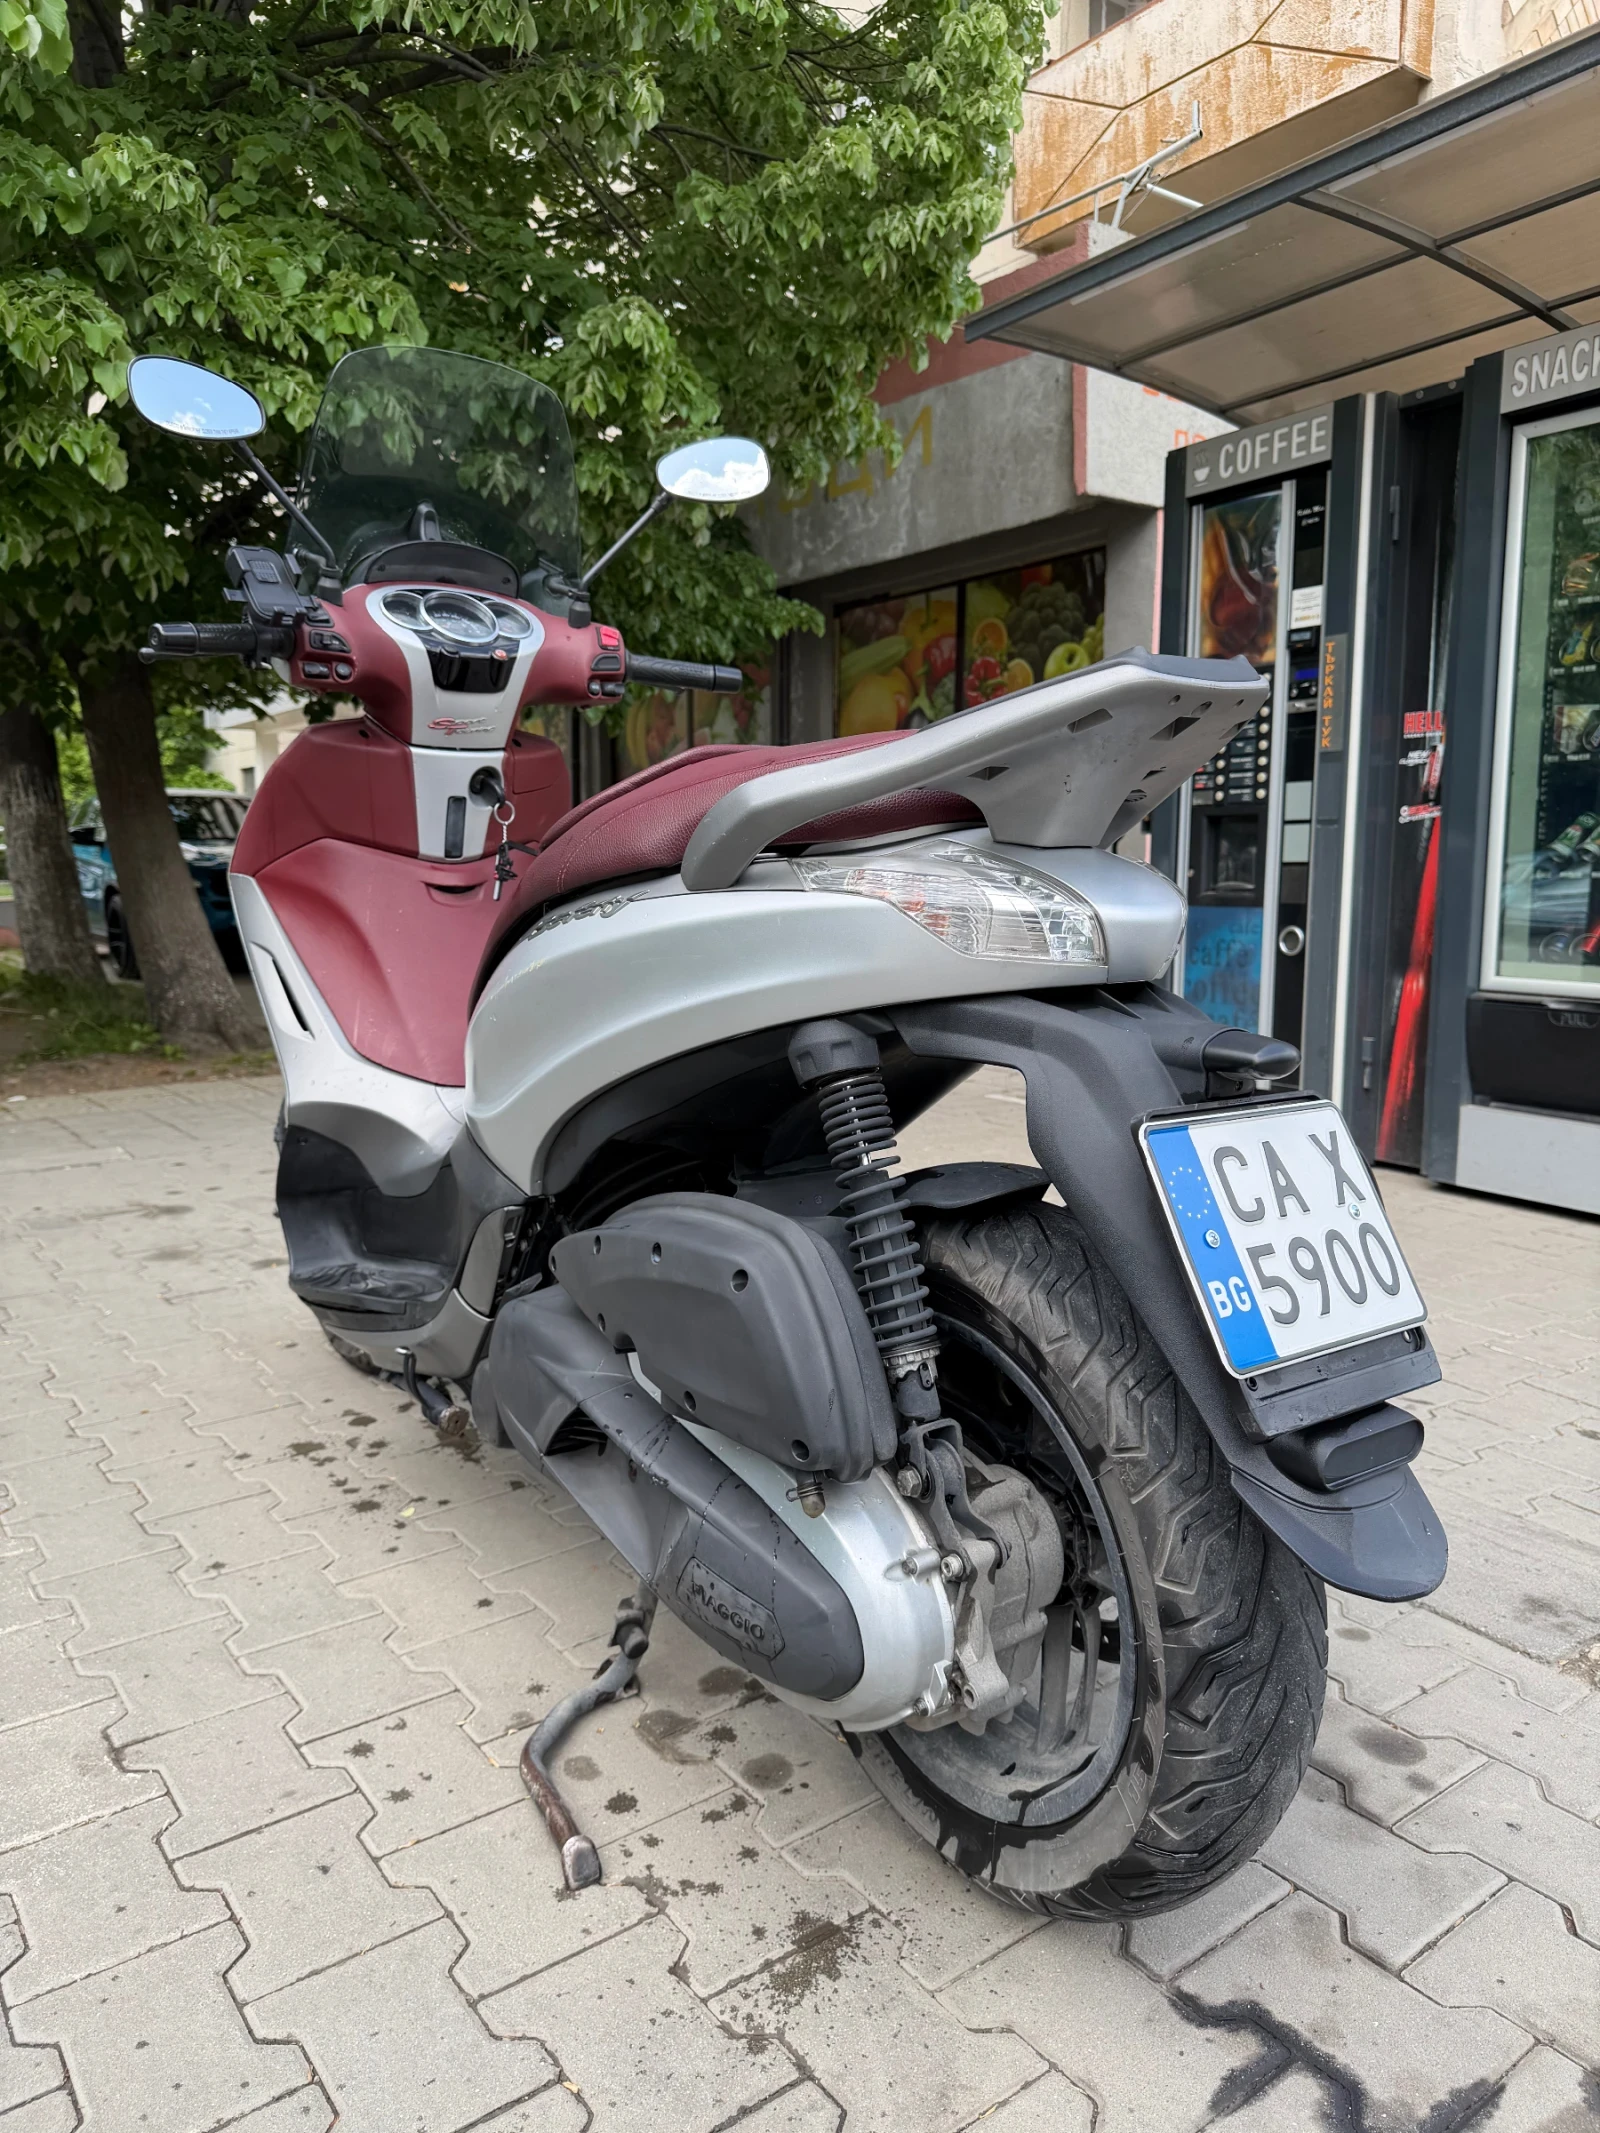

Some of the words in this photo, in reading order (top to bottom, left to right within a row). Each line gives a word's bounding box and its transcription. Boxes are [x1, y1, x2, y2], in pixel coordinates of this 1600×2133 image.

[1218, 415, 1328, 480] COFFEE
[1321, 715, 1333, 748] ТУК
[1403, 710, 1443, 735] HELL
[1213, 1140, 1311, 1223] CA
[1308, 1130, 1366, 1206] X
[1207, 1276, 1252, 1319] BG
[1246, 1222, 1401, 1326] 5900
